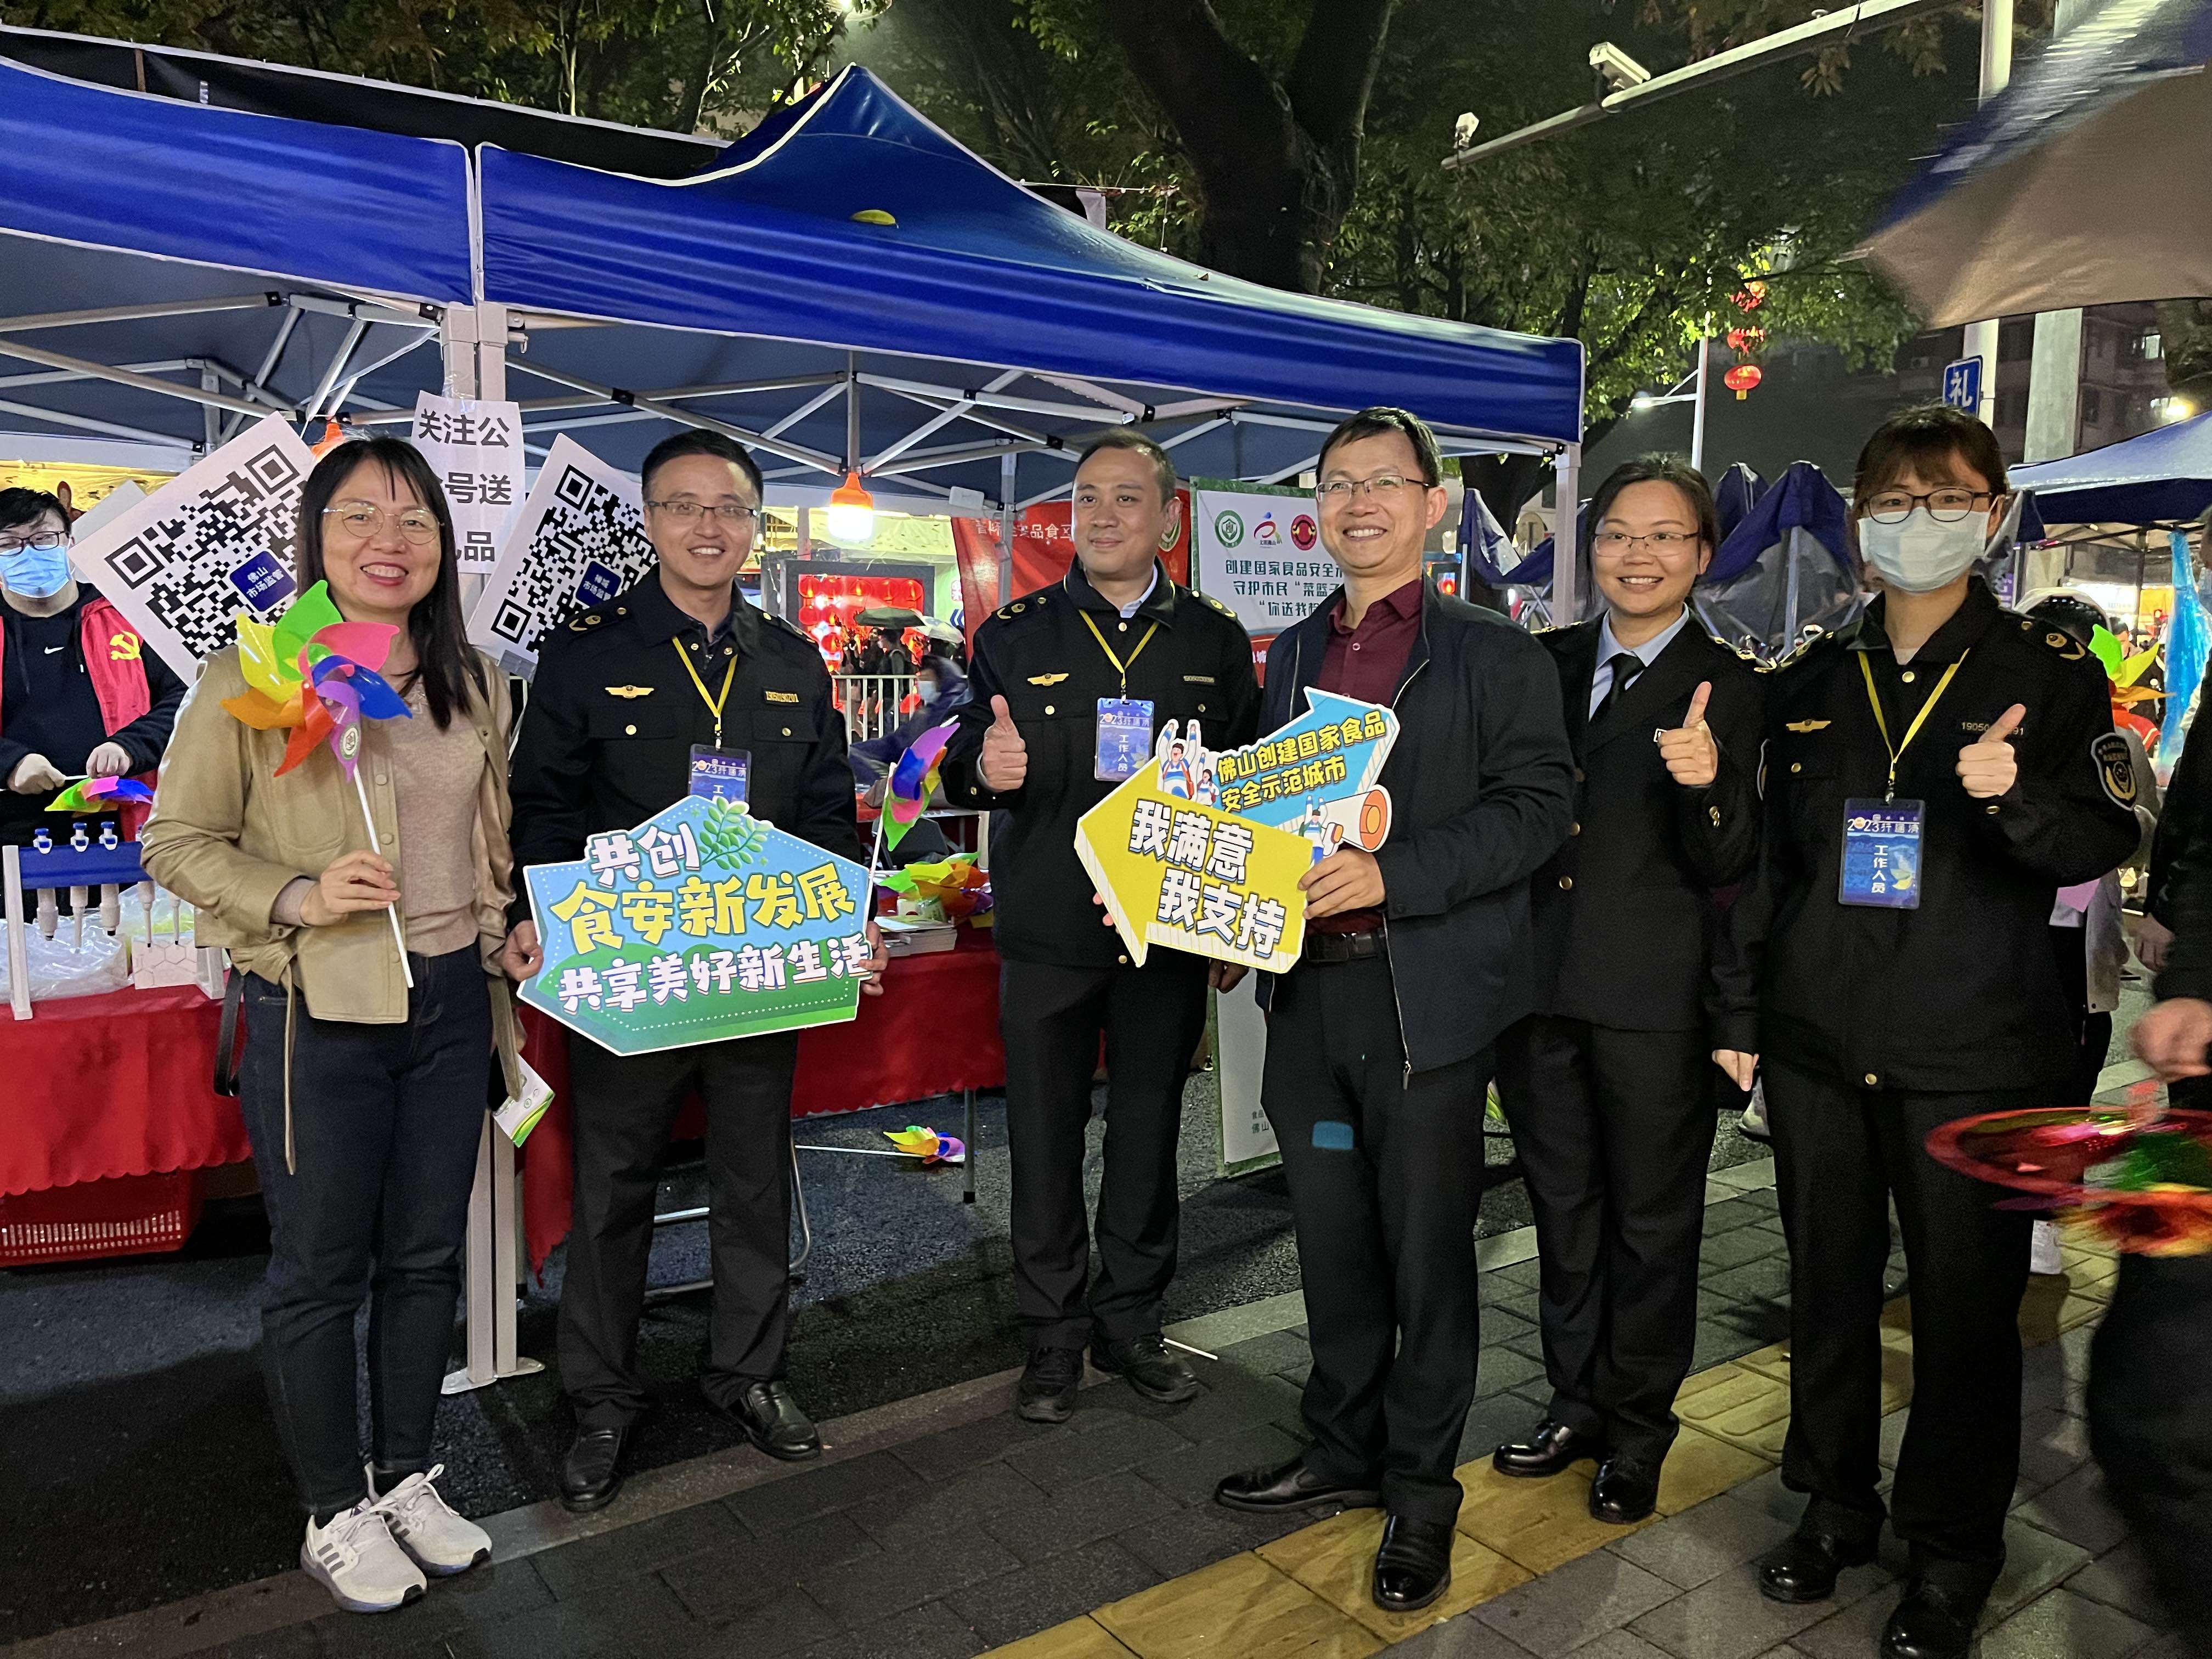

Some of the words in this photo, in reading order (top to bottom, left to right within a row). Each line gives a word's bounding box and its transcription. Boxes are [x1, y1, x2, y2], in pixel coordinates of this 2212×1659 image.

[1949, 369, 1972, 407] 礼
[419, 408, 510, 448] 关注公
[439, 472, 511, 505] 号送
[456, 531, 495, 561] 品
[1118, 735, 1129, 772] 工作人员
[1218, 711, 1386, 784] 佛山创建国家食品
[1221, 756, 1346, 813] 安全示范城市
[591, 823, 699, 888] 共创
[1128, 800, 1253, 884] 我满意
[1871, 845, 1888, 893] 工作人员
[550, 862, 854, 955] 食安新发展
[1157, 868, 1285, 959] 我支持
[558, 933, 871, 1015] 共享美好新生活
